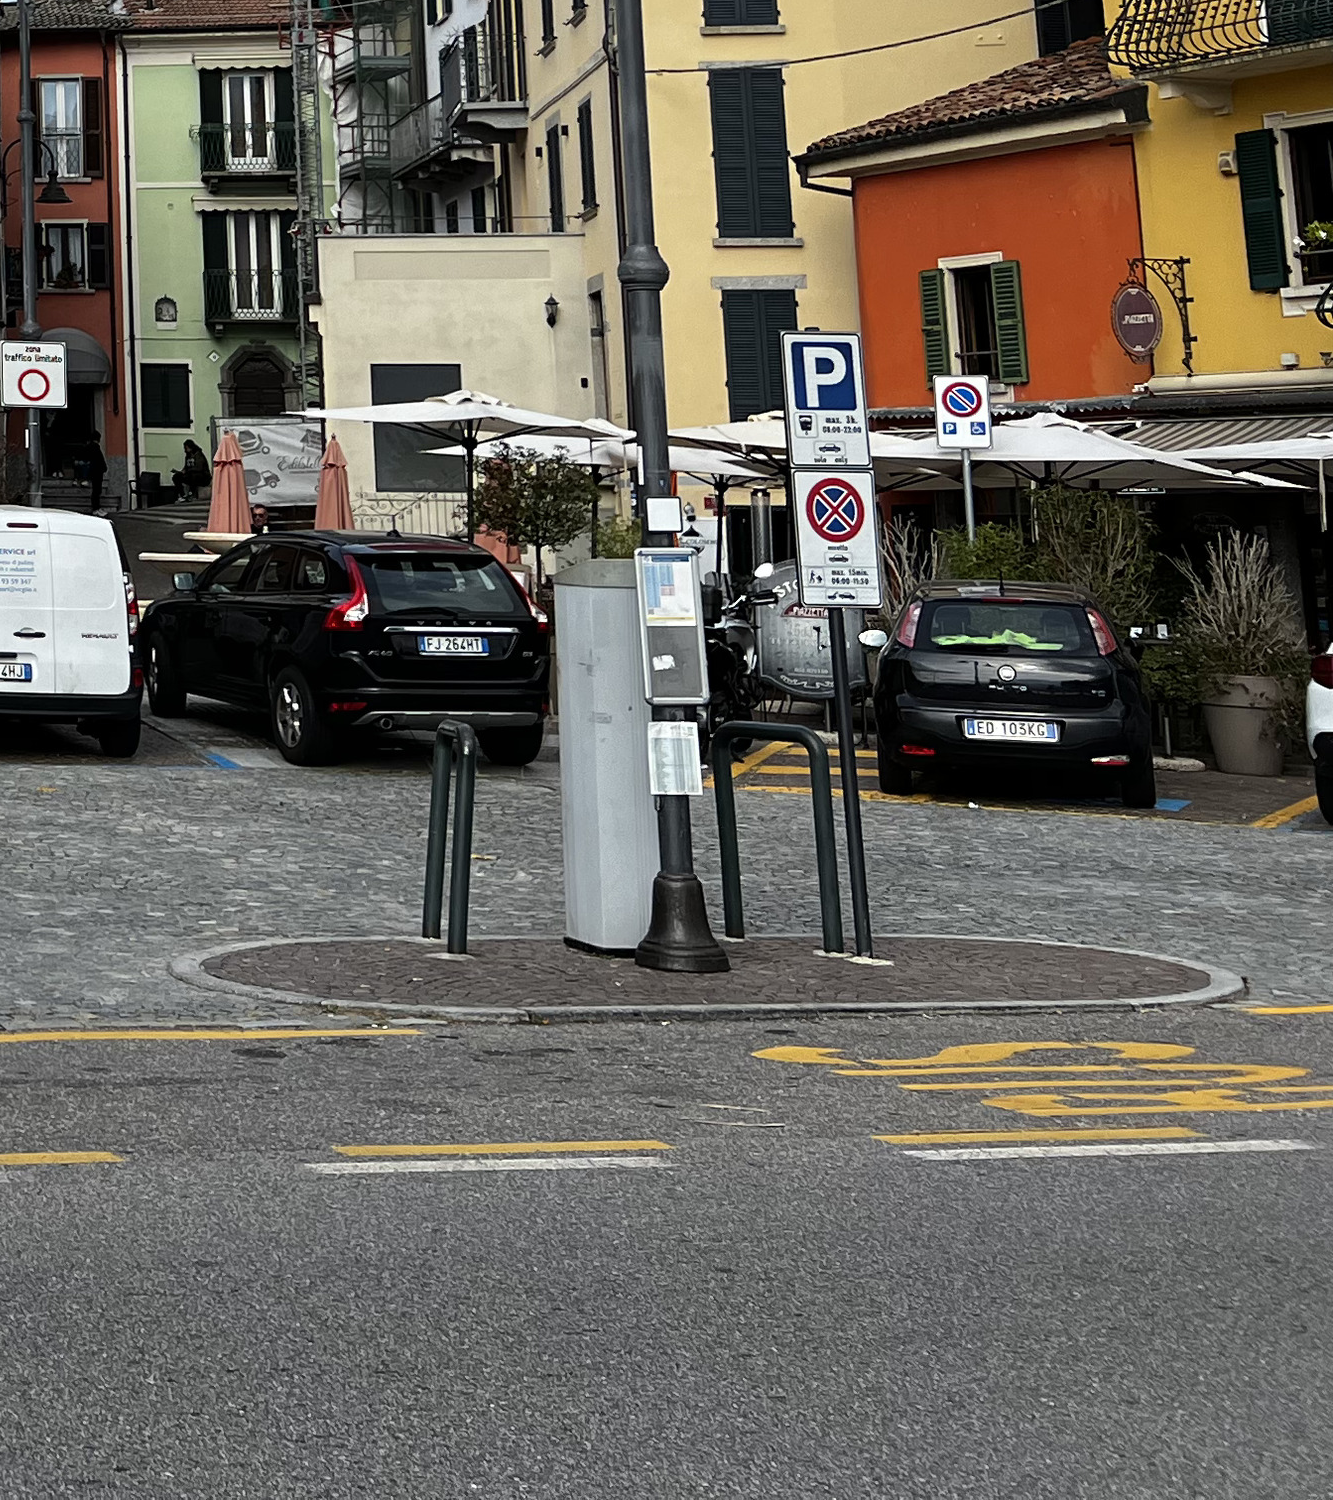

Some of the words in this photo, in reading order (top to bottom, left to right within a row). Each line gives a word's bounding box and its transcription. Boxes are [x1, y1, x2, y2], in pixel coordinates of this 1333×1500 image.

[4, 353, 32, 362] traffico
[34, 354, 63, 363] limitato
[802, 346, 847, 408] P
[945, 423, 954, 433] P
[426, 638, 441, 650] FJ
[445, 638, 480, 651] 264HT
[977, 721, 995, 734] ED
[1001, 722, 1046, 737] 103KG
